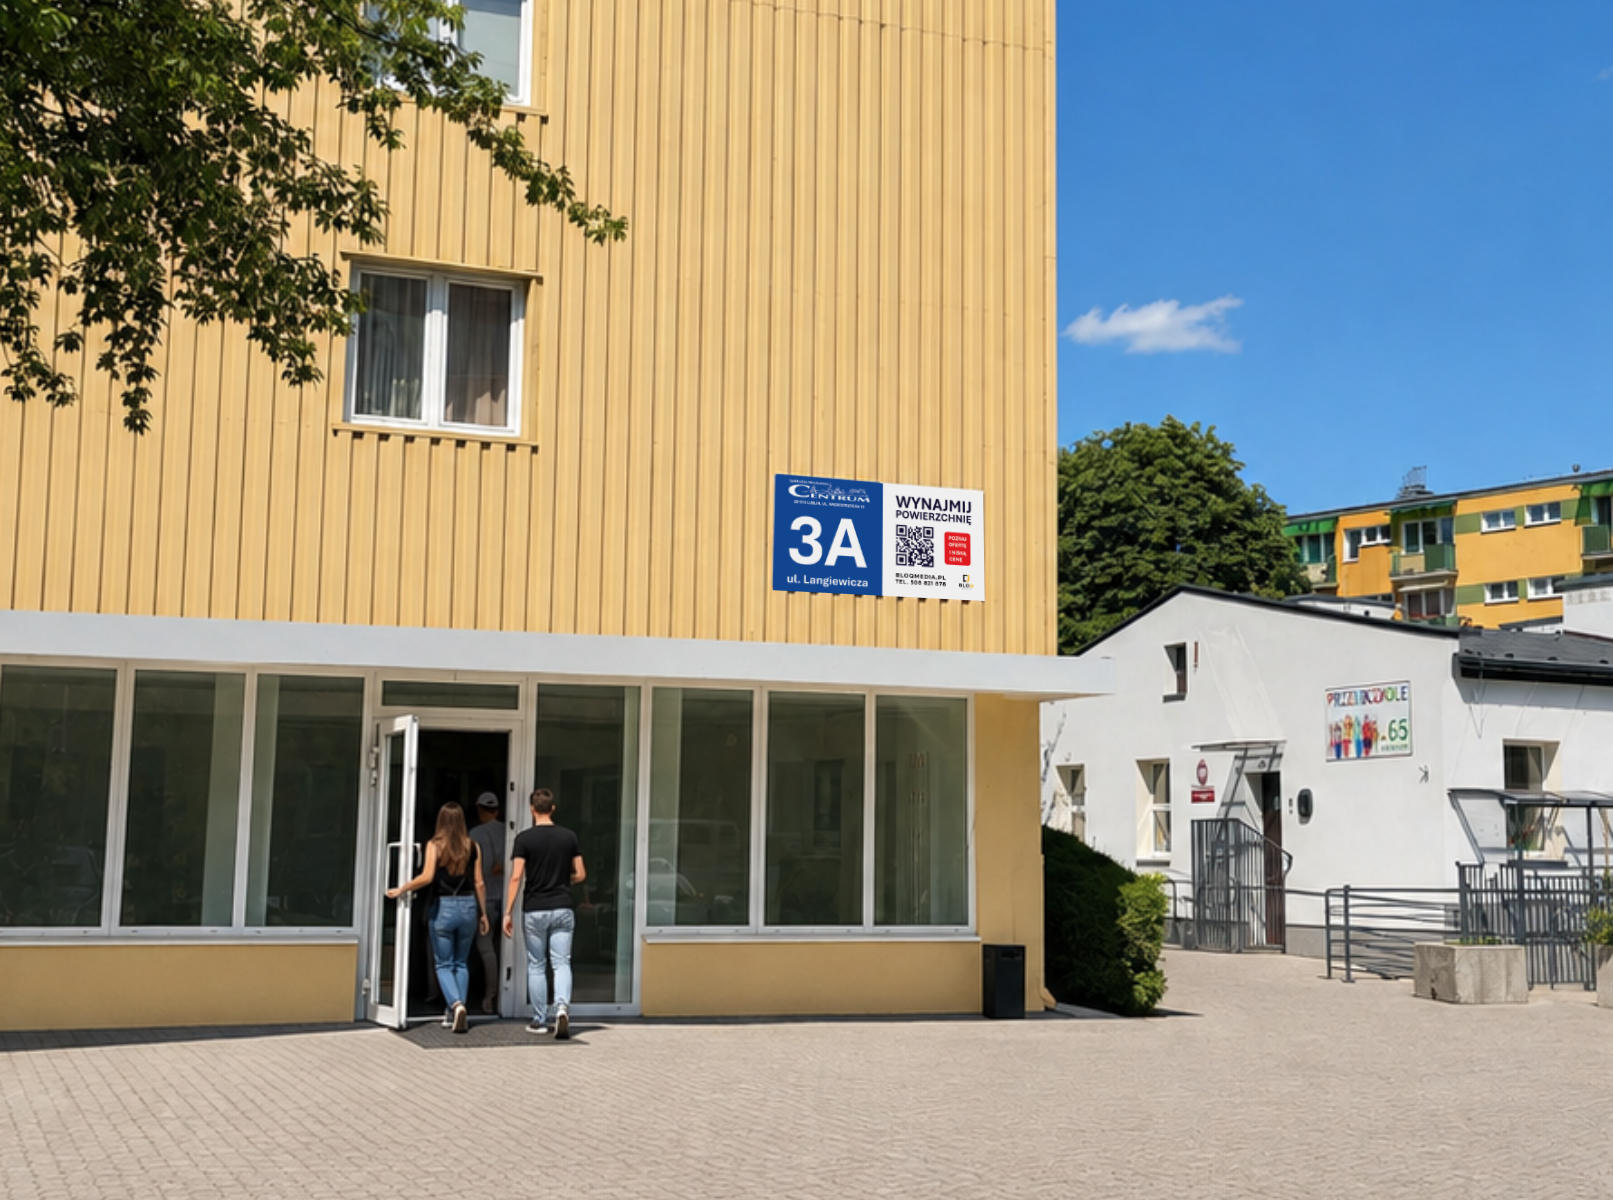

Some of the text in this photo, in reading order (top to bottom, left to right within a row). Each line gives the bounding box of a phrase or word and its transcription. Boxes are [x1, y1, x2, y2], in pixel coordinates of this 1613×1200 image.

[788, 484, 870, 503] CENTRUM
[895, 495, 972, 514] WYNAJMIJ
[895, 509, 972, 526] POWIERZCHNIĘ
[788, 515, 868, 568] 3A
[787, 574, 868, 588] ul. Langiewicza
[895, 572, 946, 580] BLOQMEDIA.PL
[1388, 718, 1408, 741] 65
